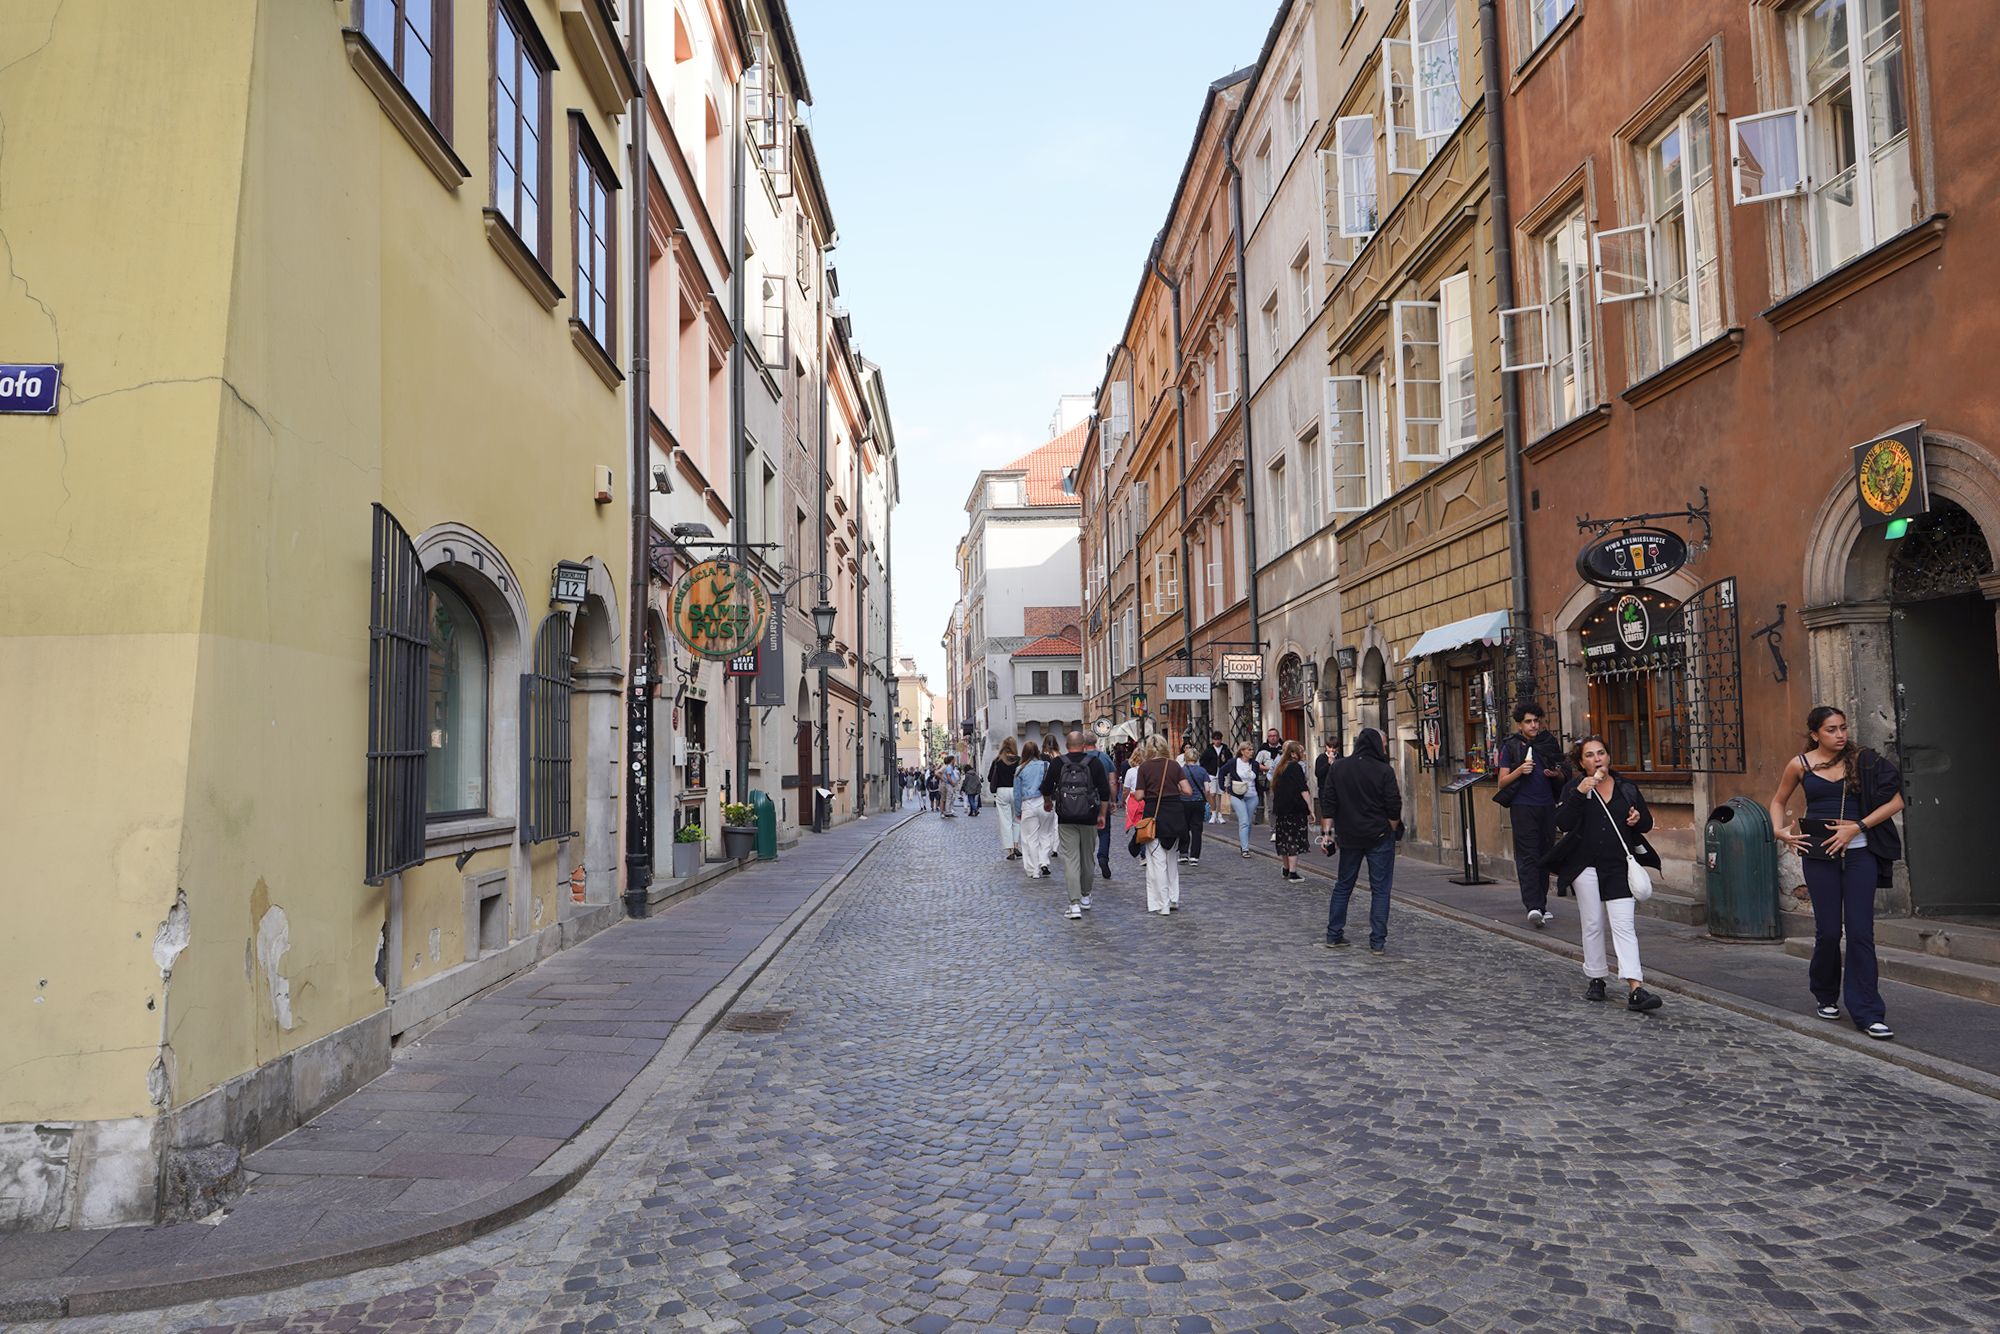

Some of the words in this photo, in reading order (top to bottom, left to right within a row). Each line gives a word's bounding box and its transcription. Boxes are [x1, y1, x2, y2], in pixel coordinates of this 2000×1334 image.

[0, 370, 42, 397] oło
[1861, 447, 1878, 474] PIWNE
[1878, 441, 1909, 461] PODZIEMIE
[1605, 541, 1621, 552] PIWO
[1621, 536, 1666, 545] RZEMIEŚLNICZE
[1611, 569, 1632, 577] POLISH
[1634, 568, 1652, 576] CRAFT
[1654, 562, 1668, 572] BEER
[566, 581, 578, 597] 12
[688, 604, 750, 620] SAME
[691, 621, 749, 638] FUSY
[1623, 620, 1644, 634] SAME
[1602, 643, 1616, 654] BEER
[733, 663, 754, 671] BEER
[1231, 664, 1254, 672] LODY
[1168, 684, 1209, 693] MERPRE
